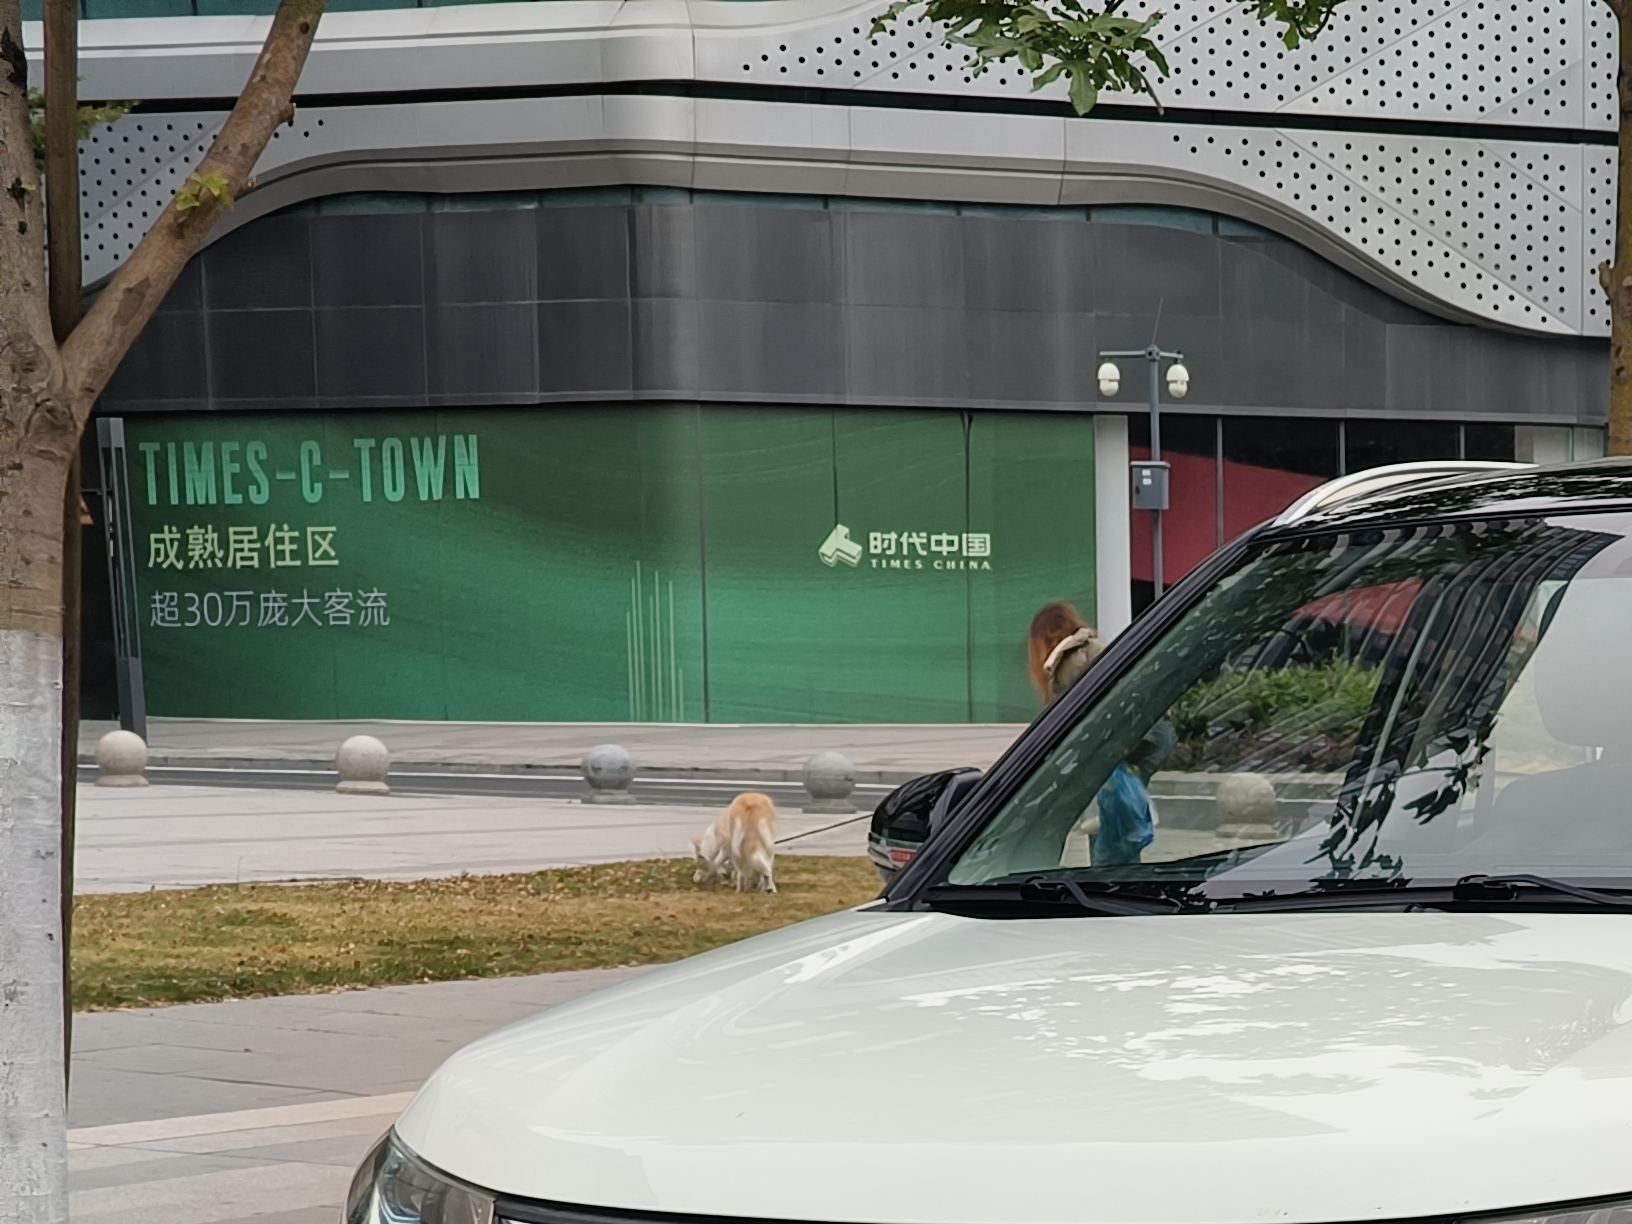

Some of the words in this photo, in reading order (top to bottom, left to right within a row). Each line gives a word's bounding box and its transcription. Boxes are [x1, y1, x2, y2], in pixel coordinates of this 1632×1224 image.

[138, 434, 481, 505] TIMES-C-TOWN
[147, 523, 340, 570] 成熟居住区
[869, 531, 991, 557] 时代中国
[870, 559, 923, 569] TIMES
[933, 560, 991, 570] CHINA
[149, 587, 391, 628] 超30万庞大客流
